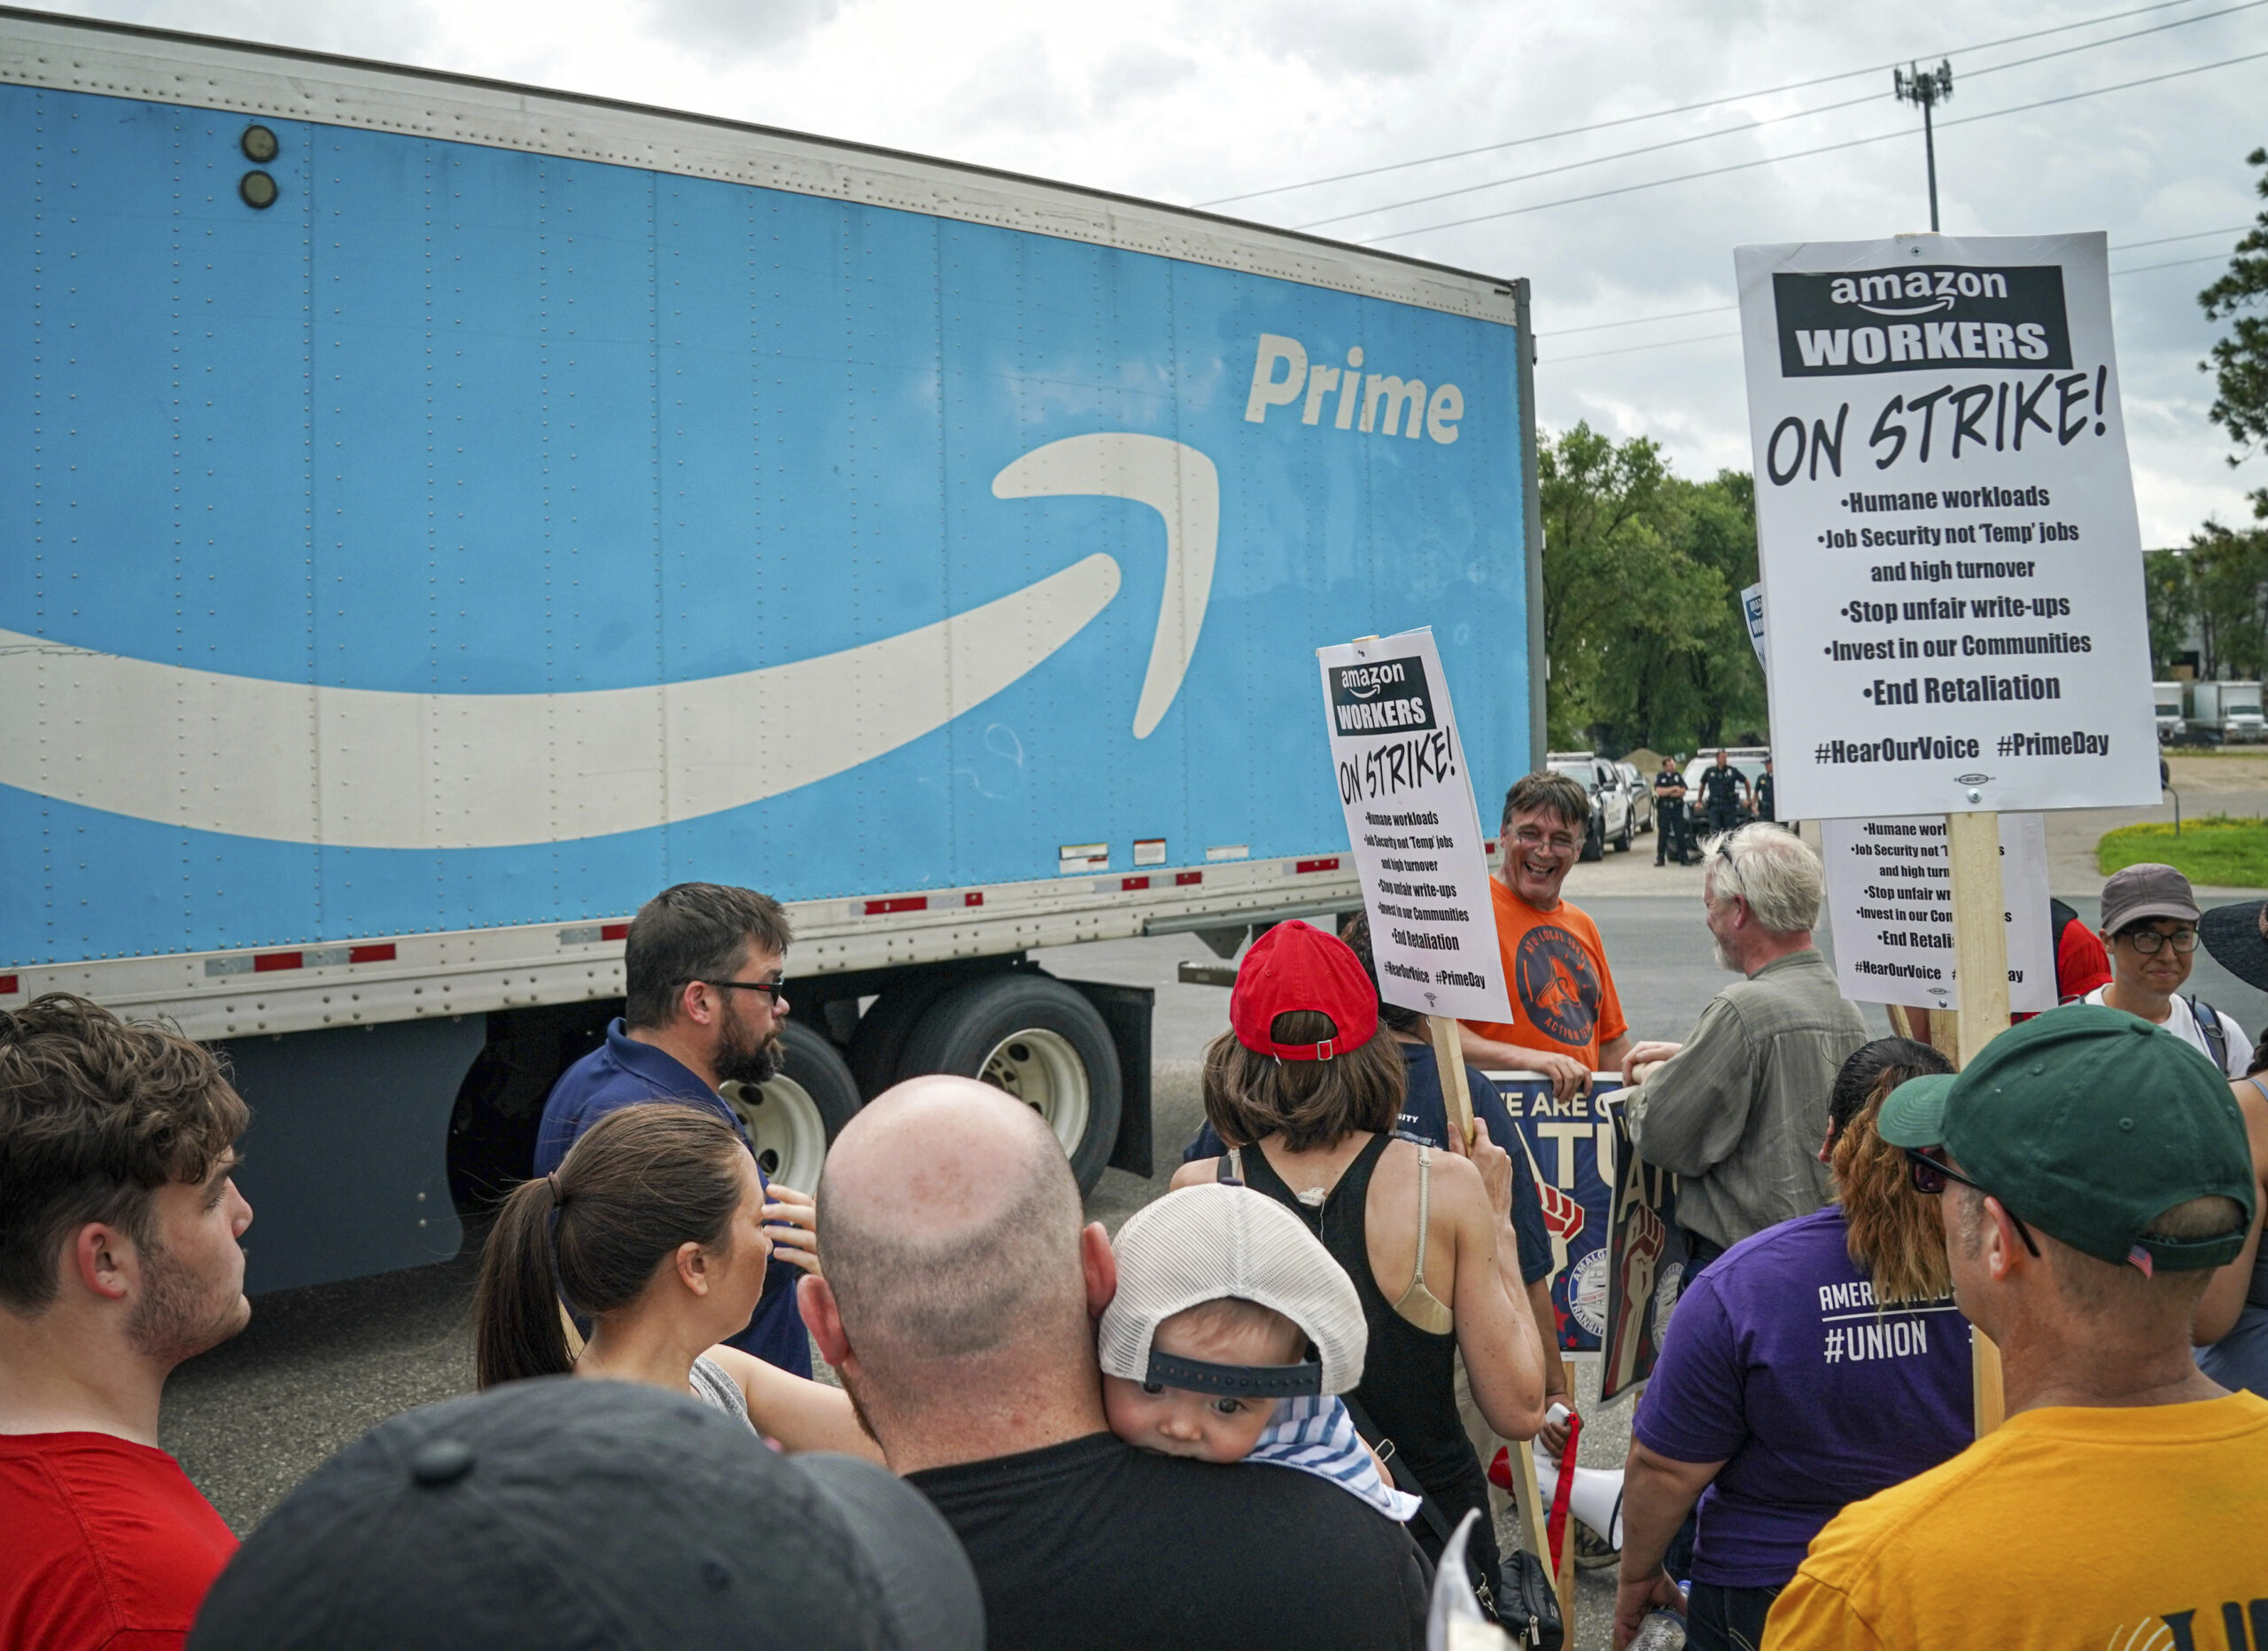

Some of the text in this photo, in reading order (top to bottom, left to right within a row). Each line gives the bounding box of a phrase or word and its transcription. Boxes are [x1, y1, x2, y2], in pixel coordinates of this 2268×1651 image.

[1830, 271, 2008, 303] amazon
[1796, 322, 2048, 367] WORKERS
[1245, 333, 1464, 444] Prime
[1767, 365, 2108, 487] ON STRIKE!
[1942, 486, 2050, 509] workloads
[1861, 526, 1940, 547] Security
[1946, 526, 1976, 543] not
[2039, 521, 2079, 543] jobs
[1871, 559, 2035, 581] and high turnover
[1903, 597, 1967, 620] unfair
[1971, 596, 2070, 619] write-ups
[1899, 638, 1918, 658] in
[1923, 639, 1957, 658] our
[1961, 633, 2092, 656] Communities
[1341, 663, 1405, 689] amazon
[1925, 674, 2061, 703] Retaliation
[1337, 697, 1426, 730] WORKERS
[1814, 731, 2109, 764] #HearOurVoice #PrimeDay
[1340, 725, 1456, 806] ON STRIKE!
[1393, 811, 1439, 826] workloads
[1375, 836, 1397, 850] Security
[1397, 837, 1410, 849] not
[1436, 836, 1454, 849] jobs
[1874, 845, 1918, 858] Security
[1921, 845, 1939, 857] not
[1381, 858, 1438, 872] and high turnover
[1879, 866, 1950, 879] and high turn
[1394, 882, 1412, 896] unfair
[1413, 884, 1456, 898] write-ups
[1897, 887, 1933, 900] unfair
[1396, 905, 1402, 918] in
[1402, 907, 1413, 920] our
[1413, 907, 1470, 922] Communities
[1896, 908, 1907, 921] in
[1908, 910, 1928, 922] our
[1407, 931, 1460, 951] Retaliation
[1910, 932, 1954, 948] Retali
[1384, 962, 1486, 989] #HearOurVoice #PrimeDay
[1855, 961, 1941, 980] #HearOurVoice
[1530, 1092, 1588, 1117] ARE
[1397, 1113, 1418, 1123] SITY
[1573, 1249, 1607, 1281] AMALG
[1824, 1320, 1928, 1364] #UNION
